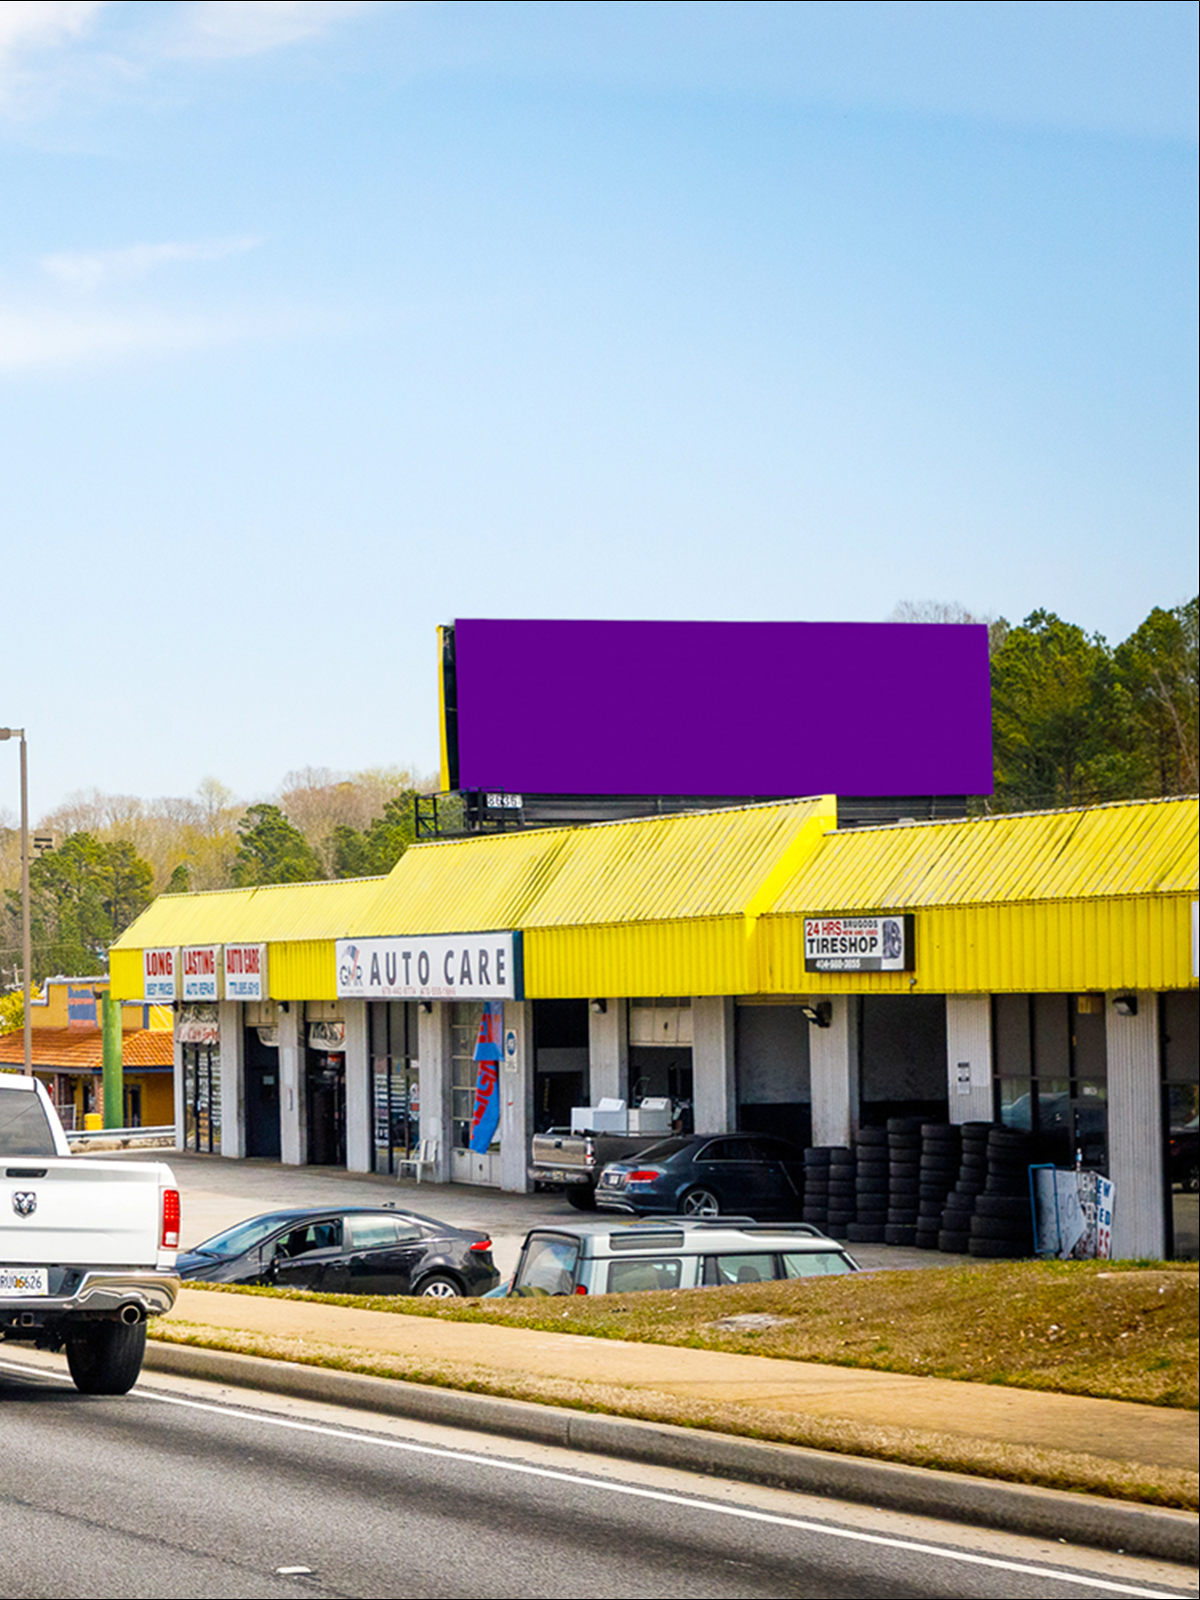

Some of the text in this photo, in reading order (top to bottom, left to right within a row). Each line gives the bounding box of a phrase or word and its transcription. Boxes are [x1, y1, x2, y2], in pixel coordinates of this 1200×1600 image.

[806, 921, 842, 936] 24 HRS
[807, 937, 878, 954] TIRESHOP
[146, 951, 172, 976] LONG
[184, 950, 215, 975] LASTING
[226, 949, 260, 974] AUTO CARE
[370, 948, 506, 986] AUTO CARE
